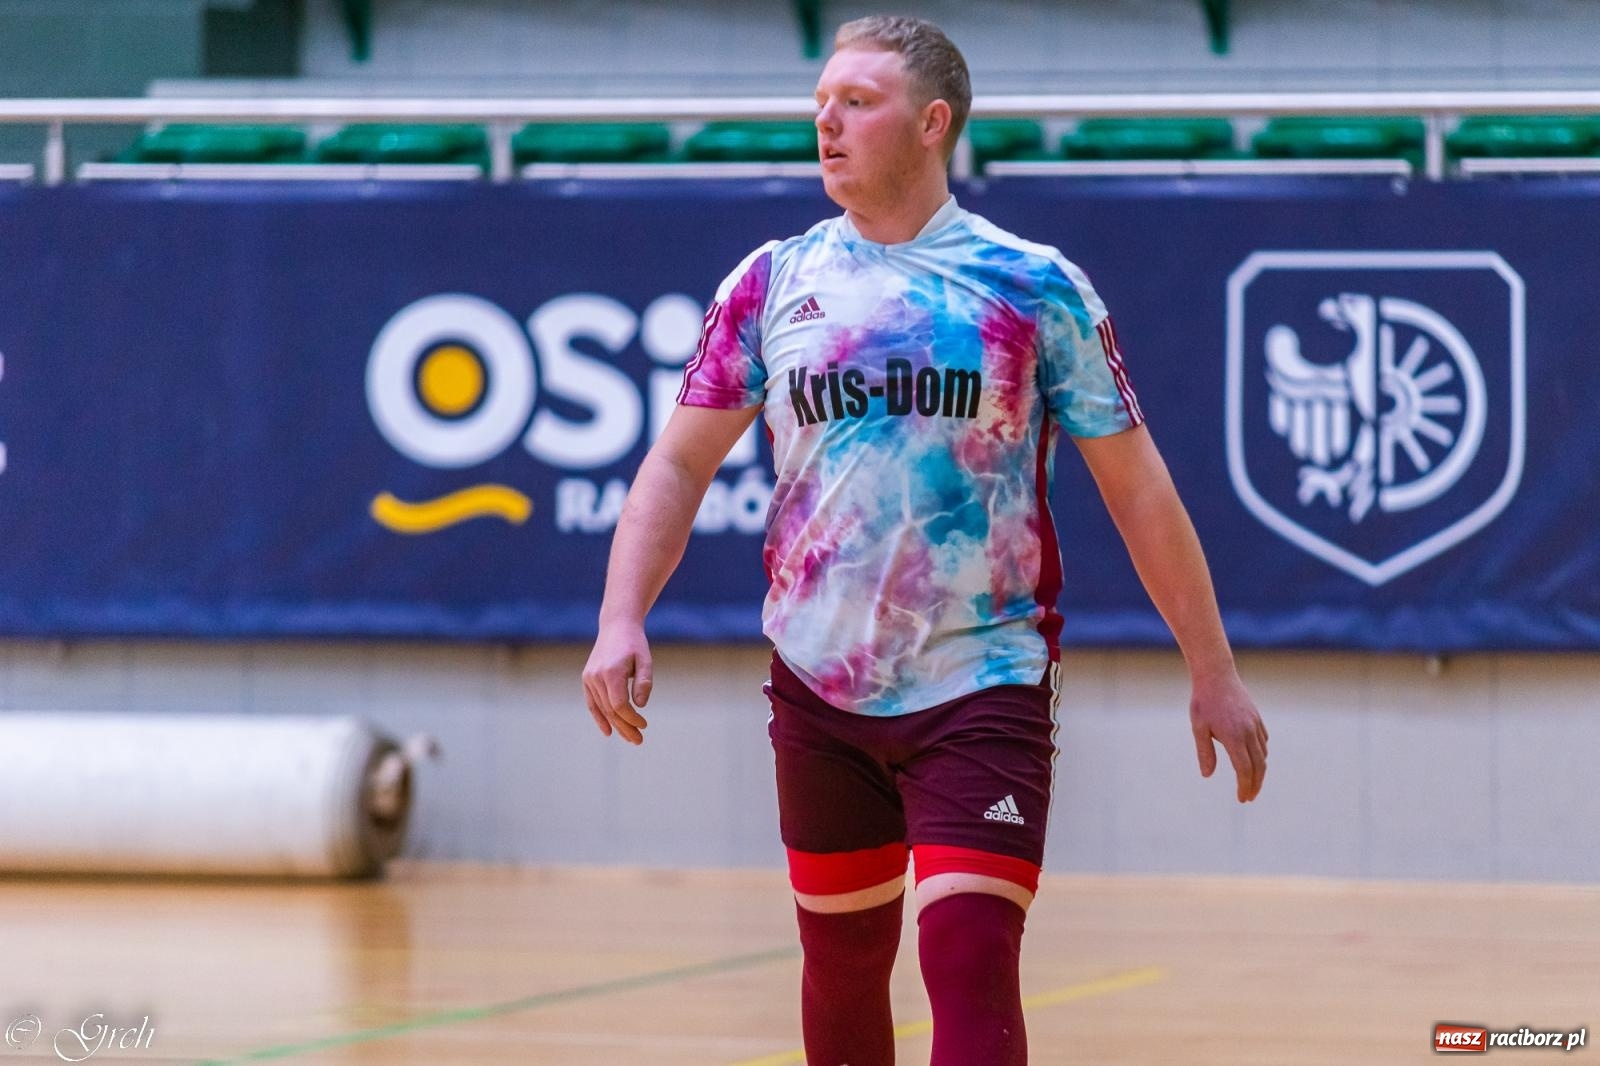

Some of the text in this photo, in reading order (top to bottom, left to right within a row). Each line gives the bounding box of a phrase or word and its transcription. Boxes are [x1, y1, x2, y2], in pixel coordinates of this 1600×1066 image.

[789, 310, 826, 325] adidas
[364, 293, 758, 469] OSi
[788, 357, 982, 428] Kris-Dom
[983, 810, 1025, 825] adidas
